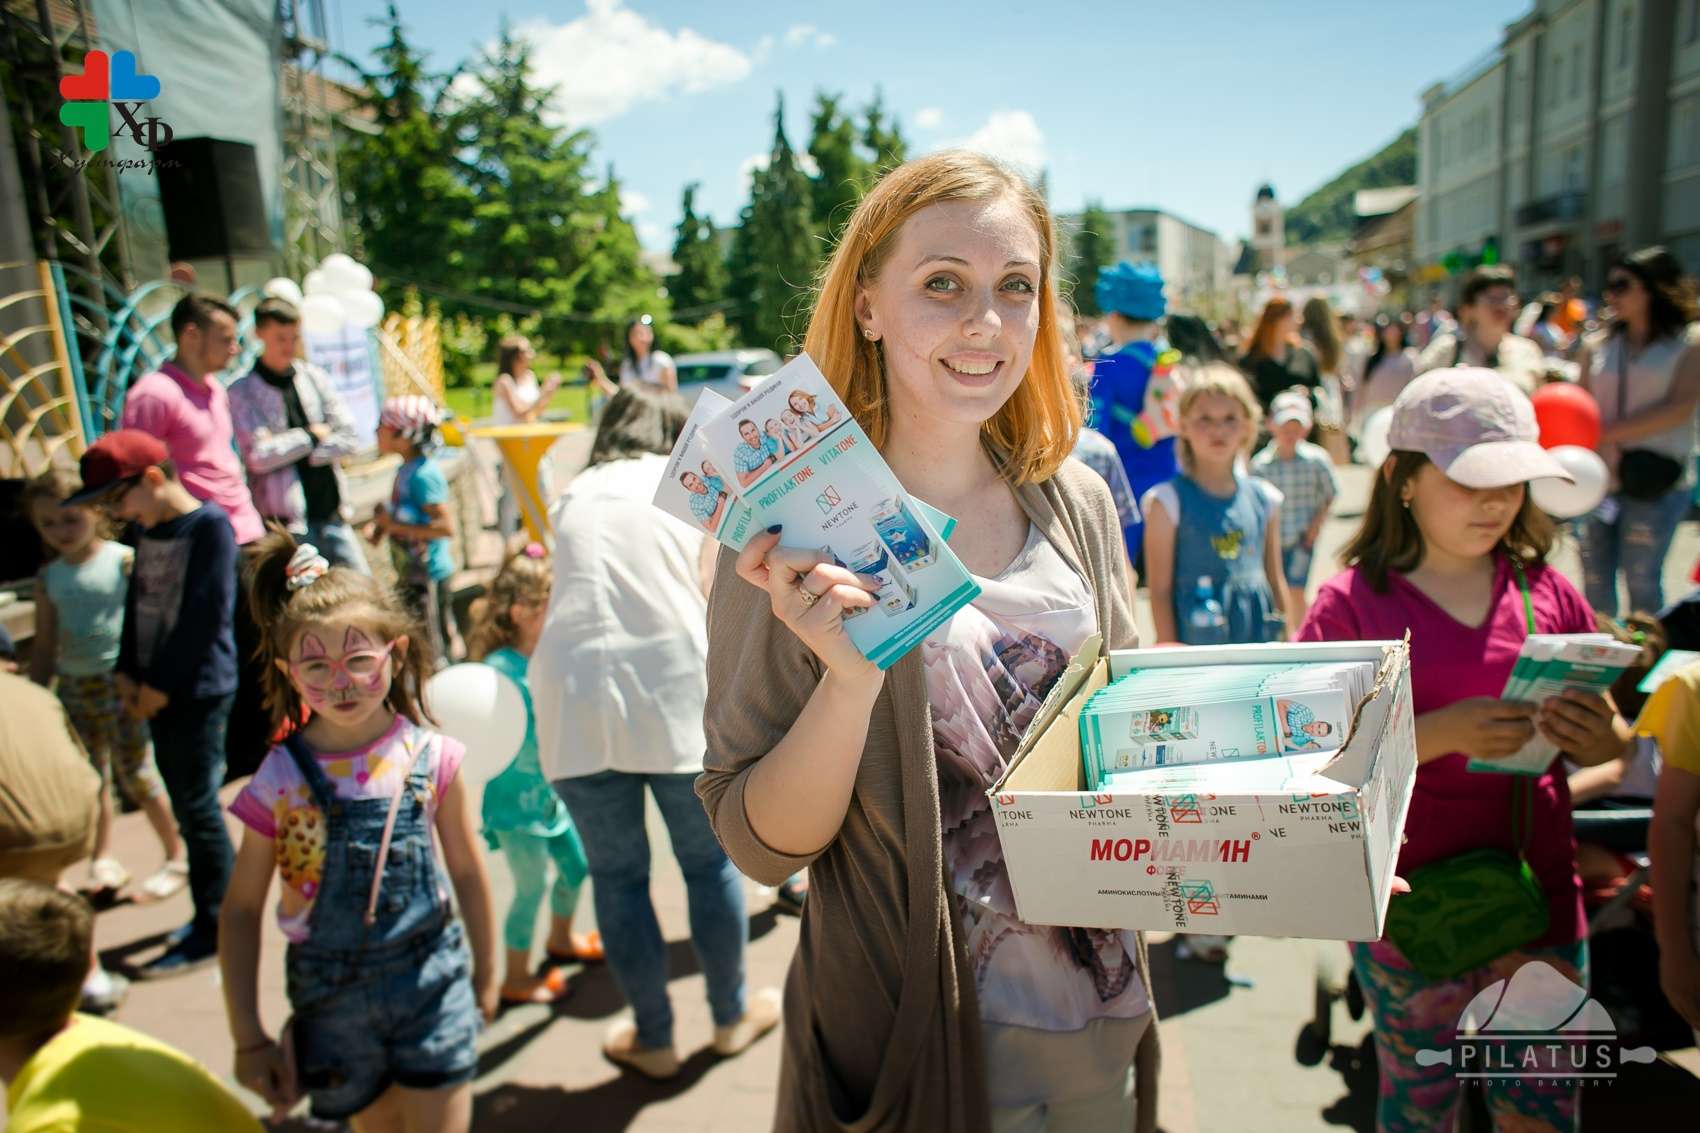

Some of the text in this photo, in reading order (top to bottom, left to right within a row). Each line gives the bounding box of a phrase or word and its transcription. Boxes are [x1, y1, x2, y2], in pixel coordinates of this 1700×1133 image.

[758, 433, 858, 510] PROFILAKTONE VITATONE
[821, 501, 859, 531] NEWTONE
[1069, 809, 1132, 820] NEWTONE
[1279, 802, 1351, 814] NEWTONE
